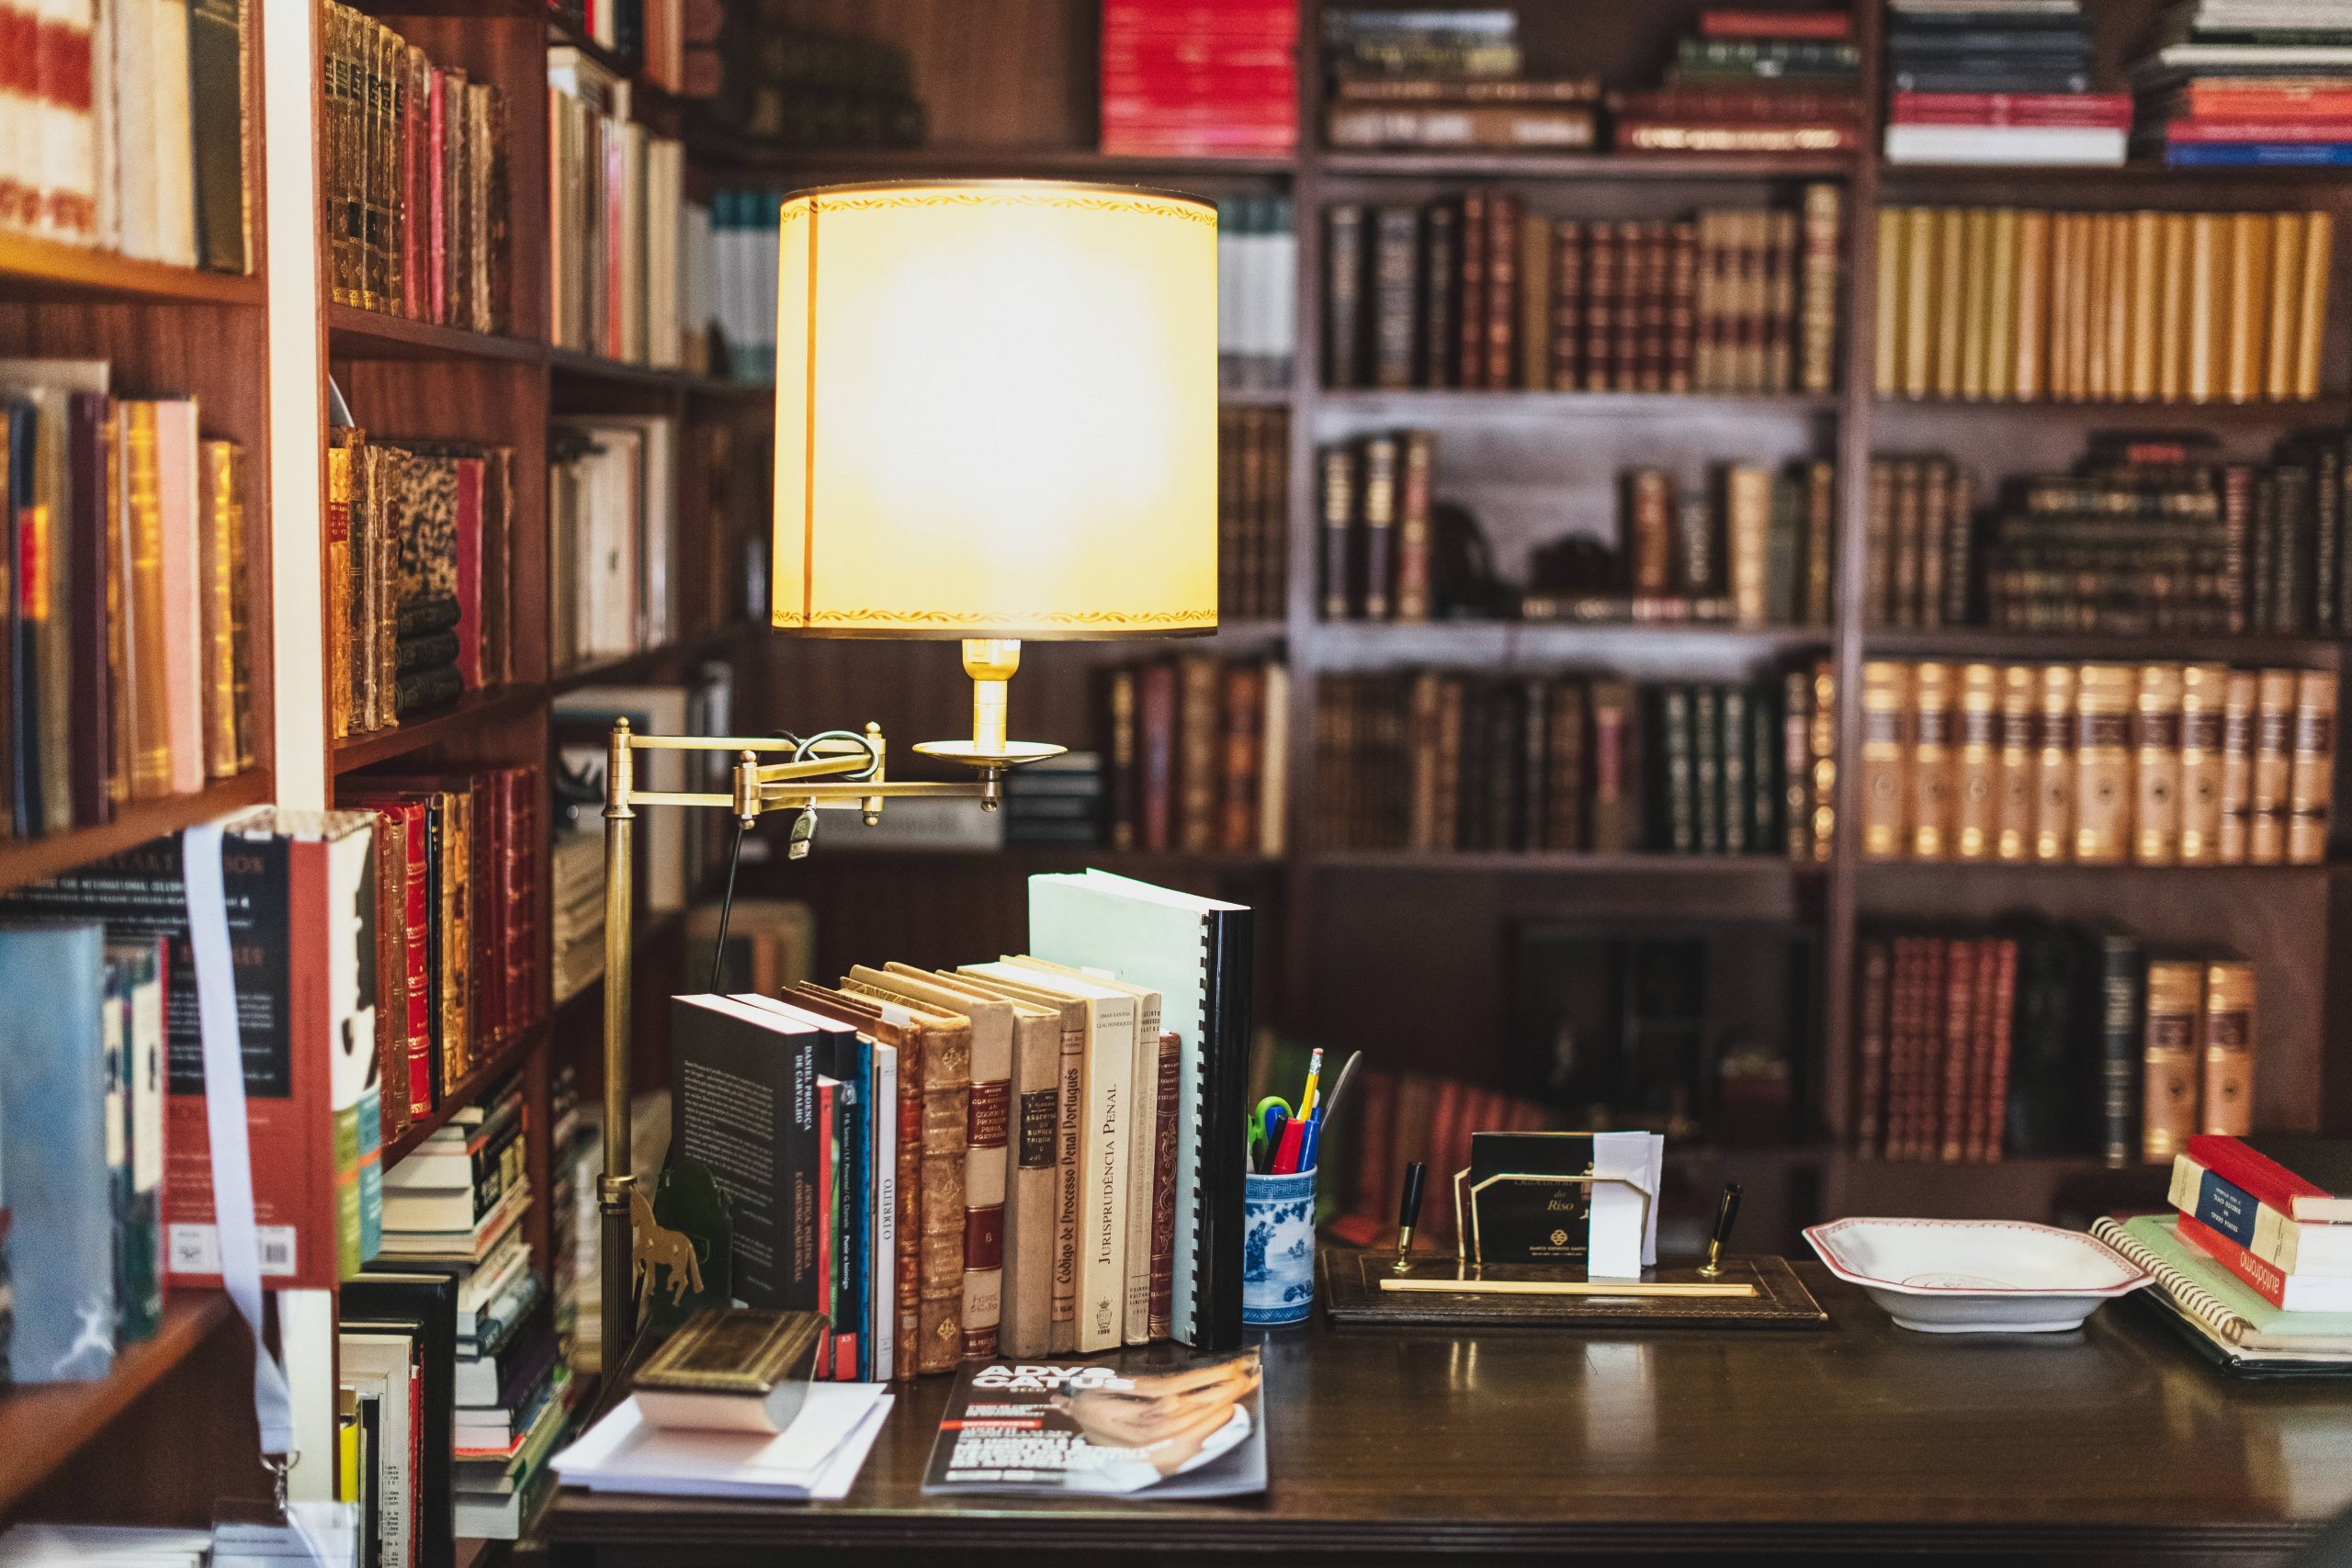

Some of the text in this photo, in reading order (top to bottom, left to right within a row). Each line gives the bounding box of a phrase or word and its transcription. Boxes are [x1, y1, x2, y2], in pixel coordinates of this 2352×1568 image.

[795, 1055, 804, 1123] DE CARVALHO
[803, 1085, 812, 1132] PROENÇA
[1057, 1068, 1080, 1283] Código de Processo Penal Português
[1099, 1084, 1117, 1264] JURISPRUDÊNCIA PENAL
[883, 1179, 892, 1240] O DIREITO
[1547, 1200, 1574, 1211] Riso
[842, 1262, 851, 1291] Inimigo
[2240, 1251, 2279, 1294] autódromo
[972, 1375, 1136, 1391] CATUS
[976, 1365, 1117, 1379] ADVO
